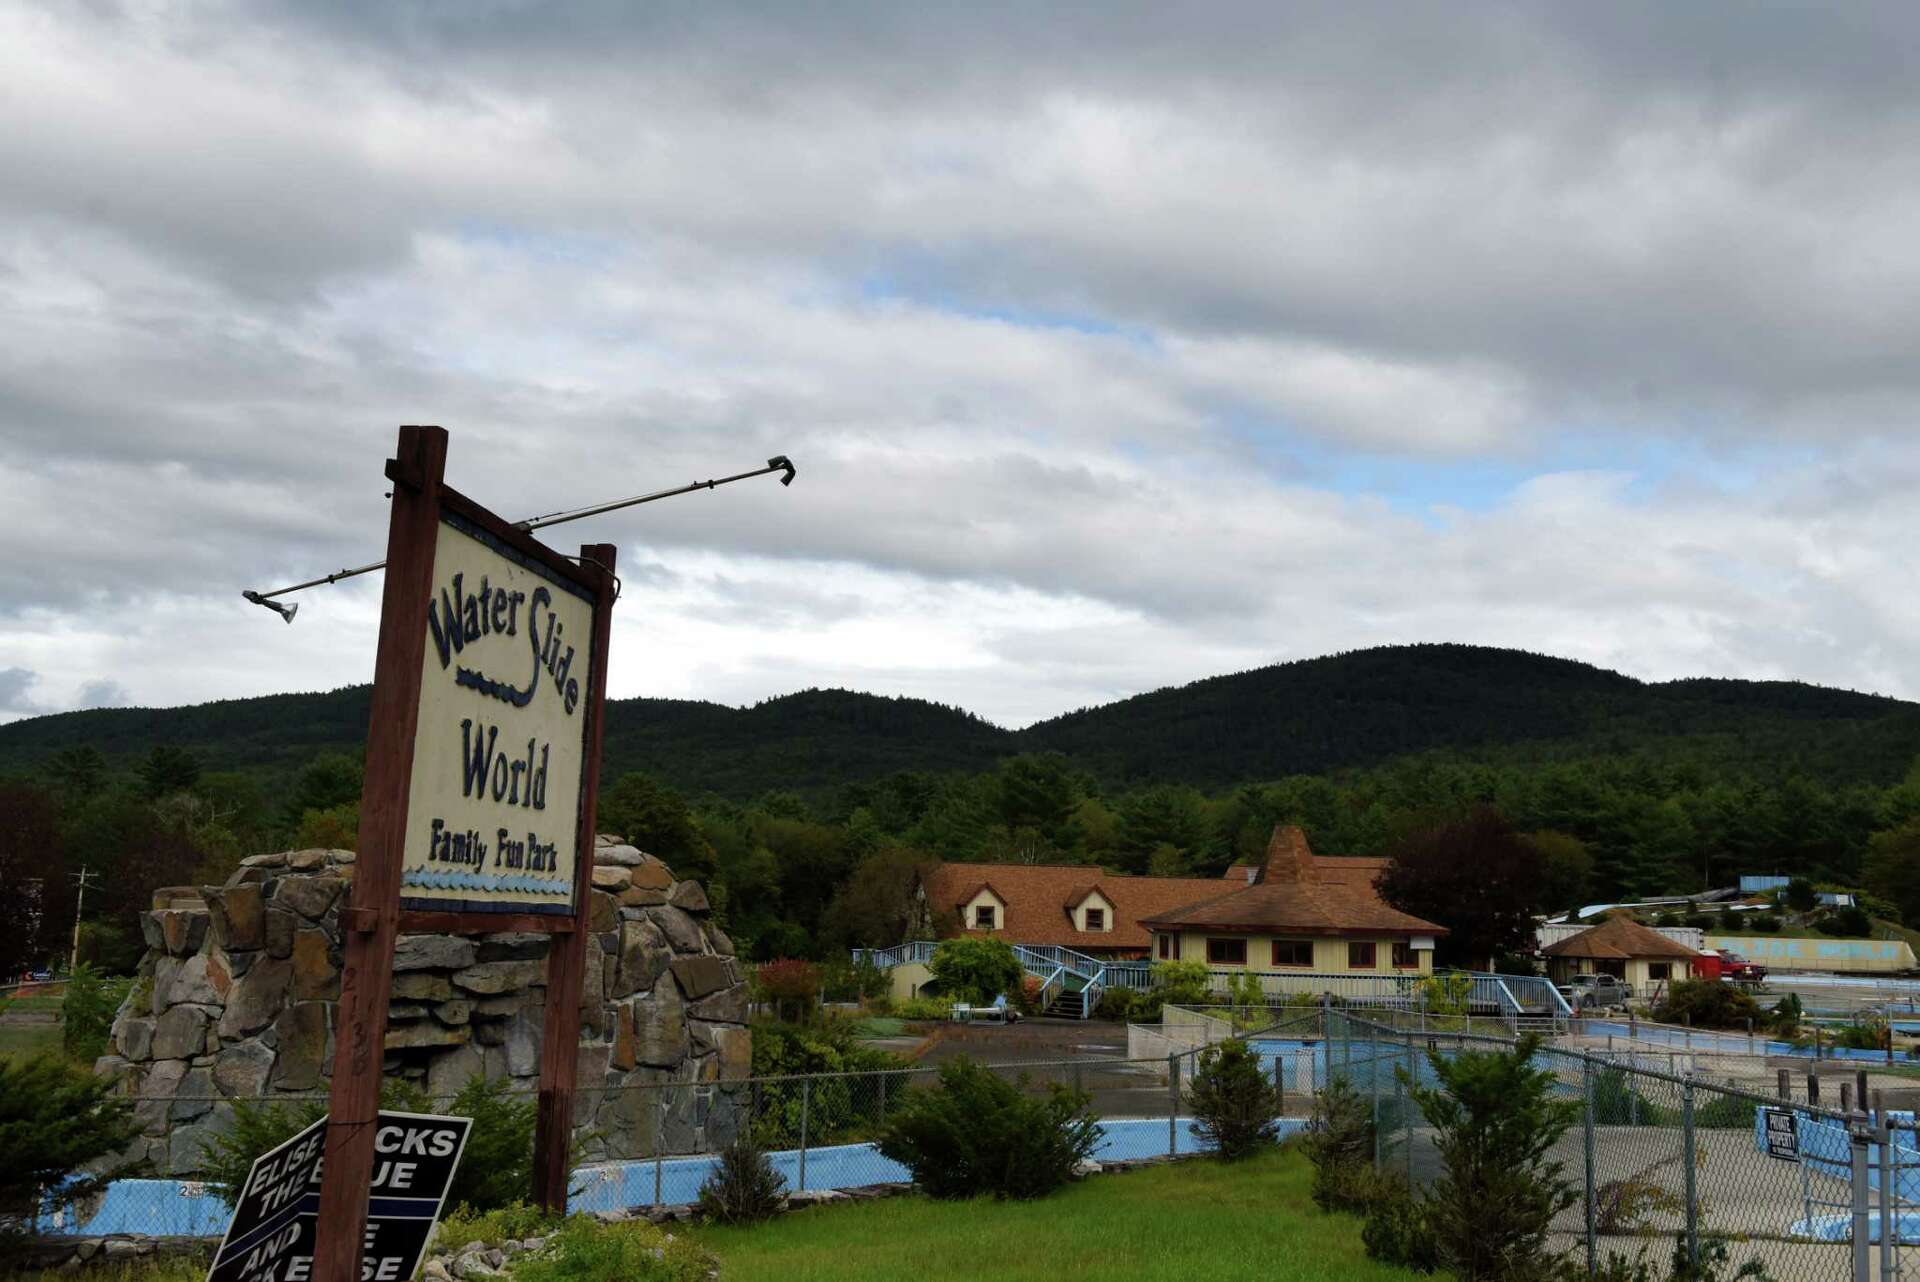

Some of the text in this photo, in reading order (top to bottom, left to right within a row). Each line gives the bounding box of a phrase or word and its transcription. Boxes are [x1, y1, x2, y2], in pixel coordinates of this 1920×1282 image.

[428, 572, 525, 670] Water
[461, 718, 549, 810] World
[429, 818, 558, 873] Family Fun Park
[249, 1126, 457, 1197] ELISE CKS
[259, 1167, 310, 1218] THE
[238, 1222, 301, 1280] AND
